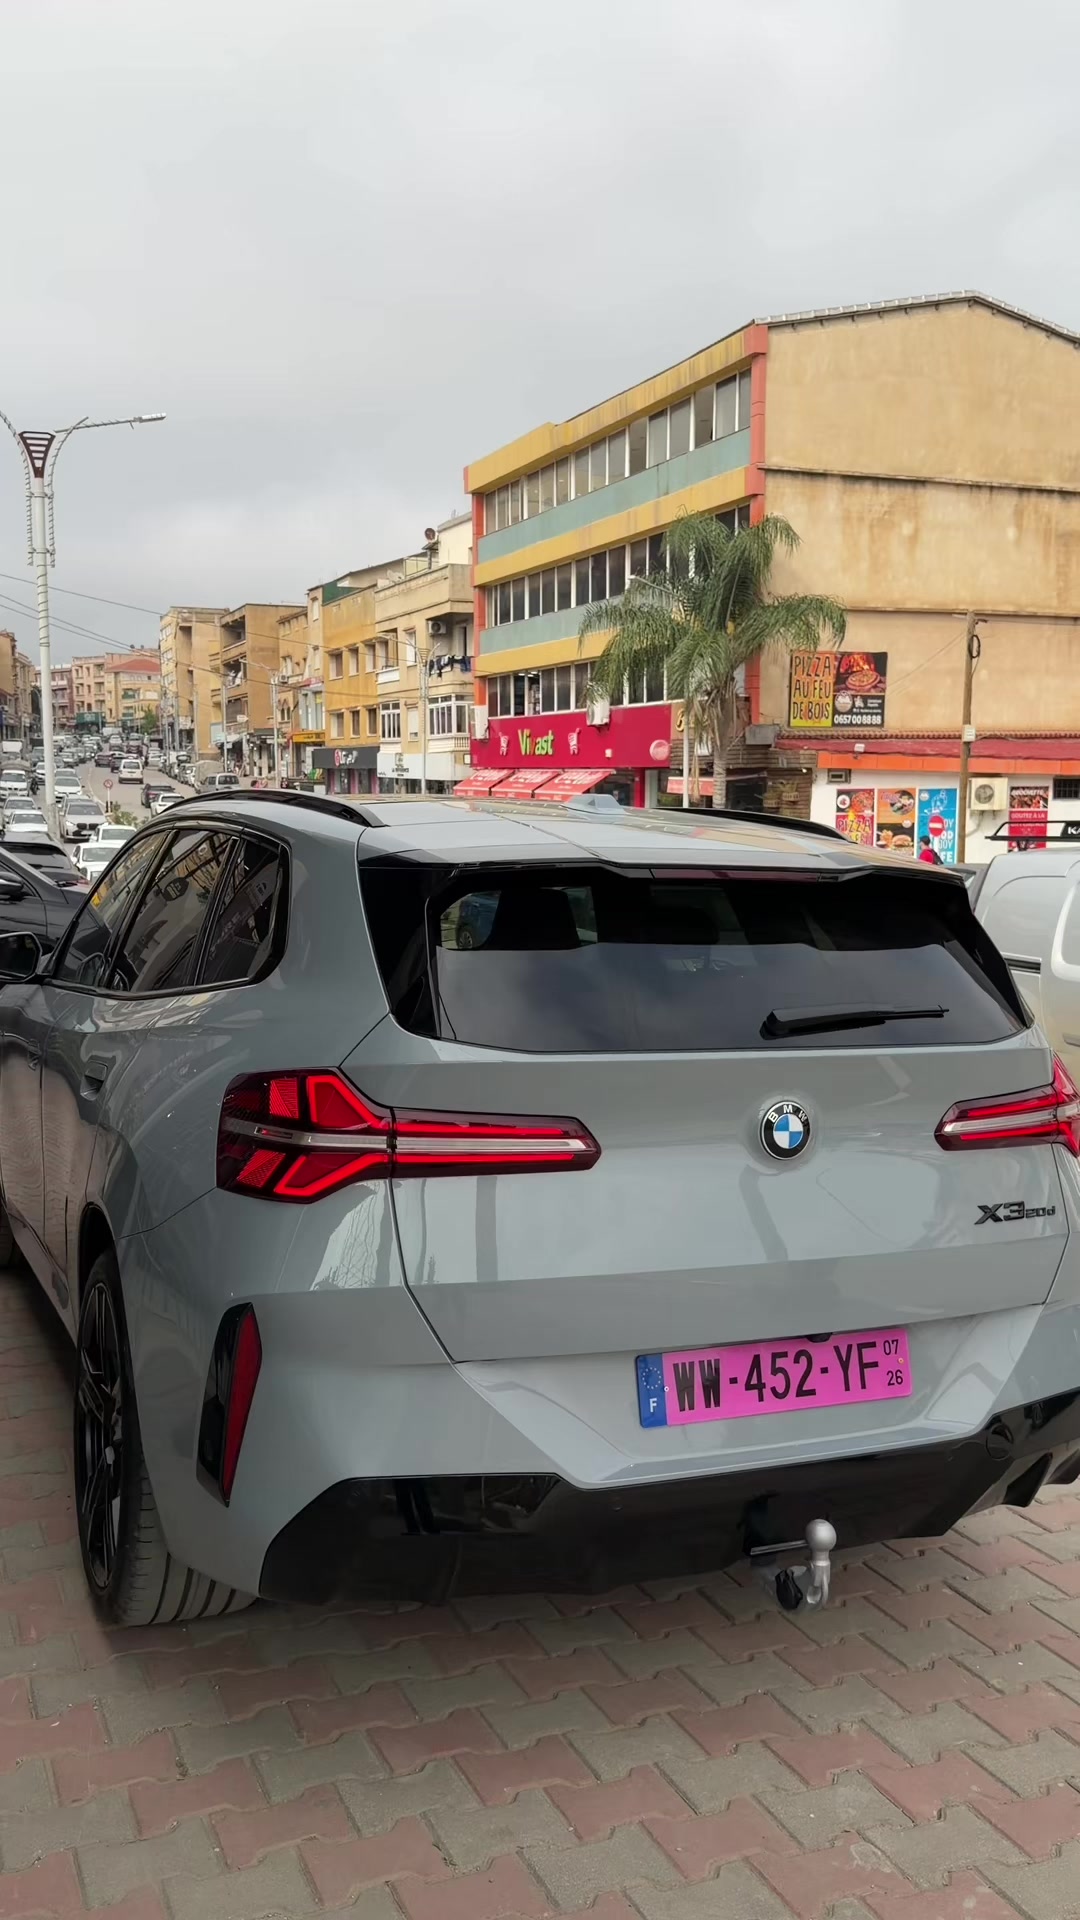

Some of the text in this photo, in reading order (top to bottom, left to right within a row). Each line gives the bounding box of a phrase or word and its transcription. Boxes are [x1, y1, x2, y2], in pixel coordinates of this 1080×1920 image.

[794, 655, 831, 677] PIZZA
[793, 679, 831, 699] AU FEU
[792, 700, 830, 720] DE BOIS
[518, 728, 554, 756] Vivast
[838, 819, 871, 832] PIZZA
[767, 1104, 808, 1123] BMW
[974, 1201, 1056, 1225] X3 20d
[883, 1338, 899, 1356] 07
[649, 1341, 879, 1413] F WW-452-YF
[886, 1369, 903, 1387] 26
